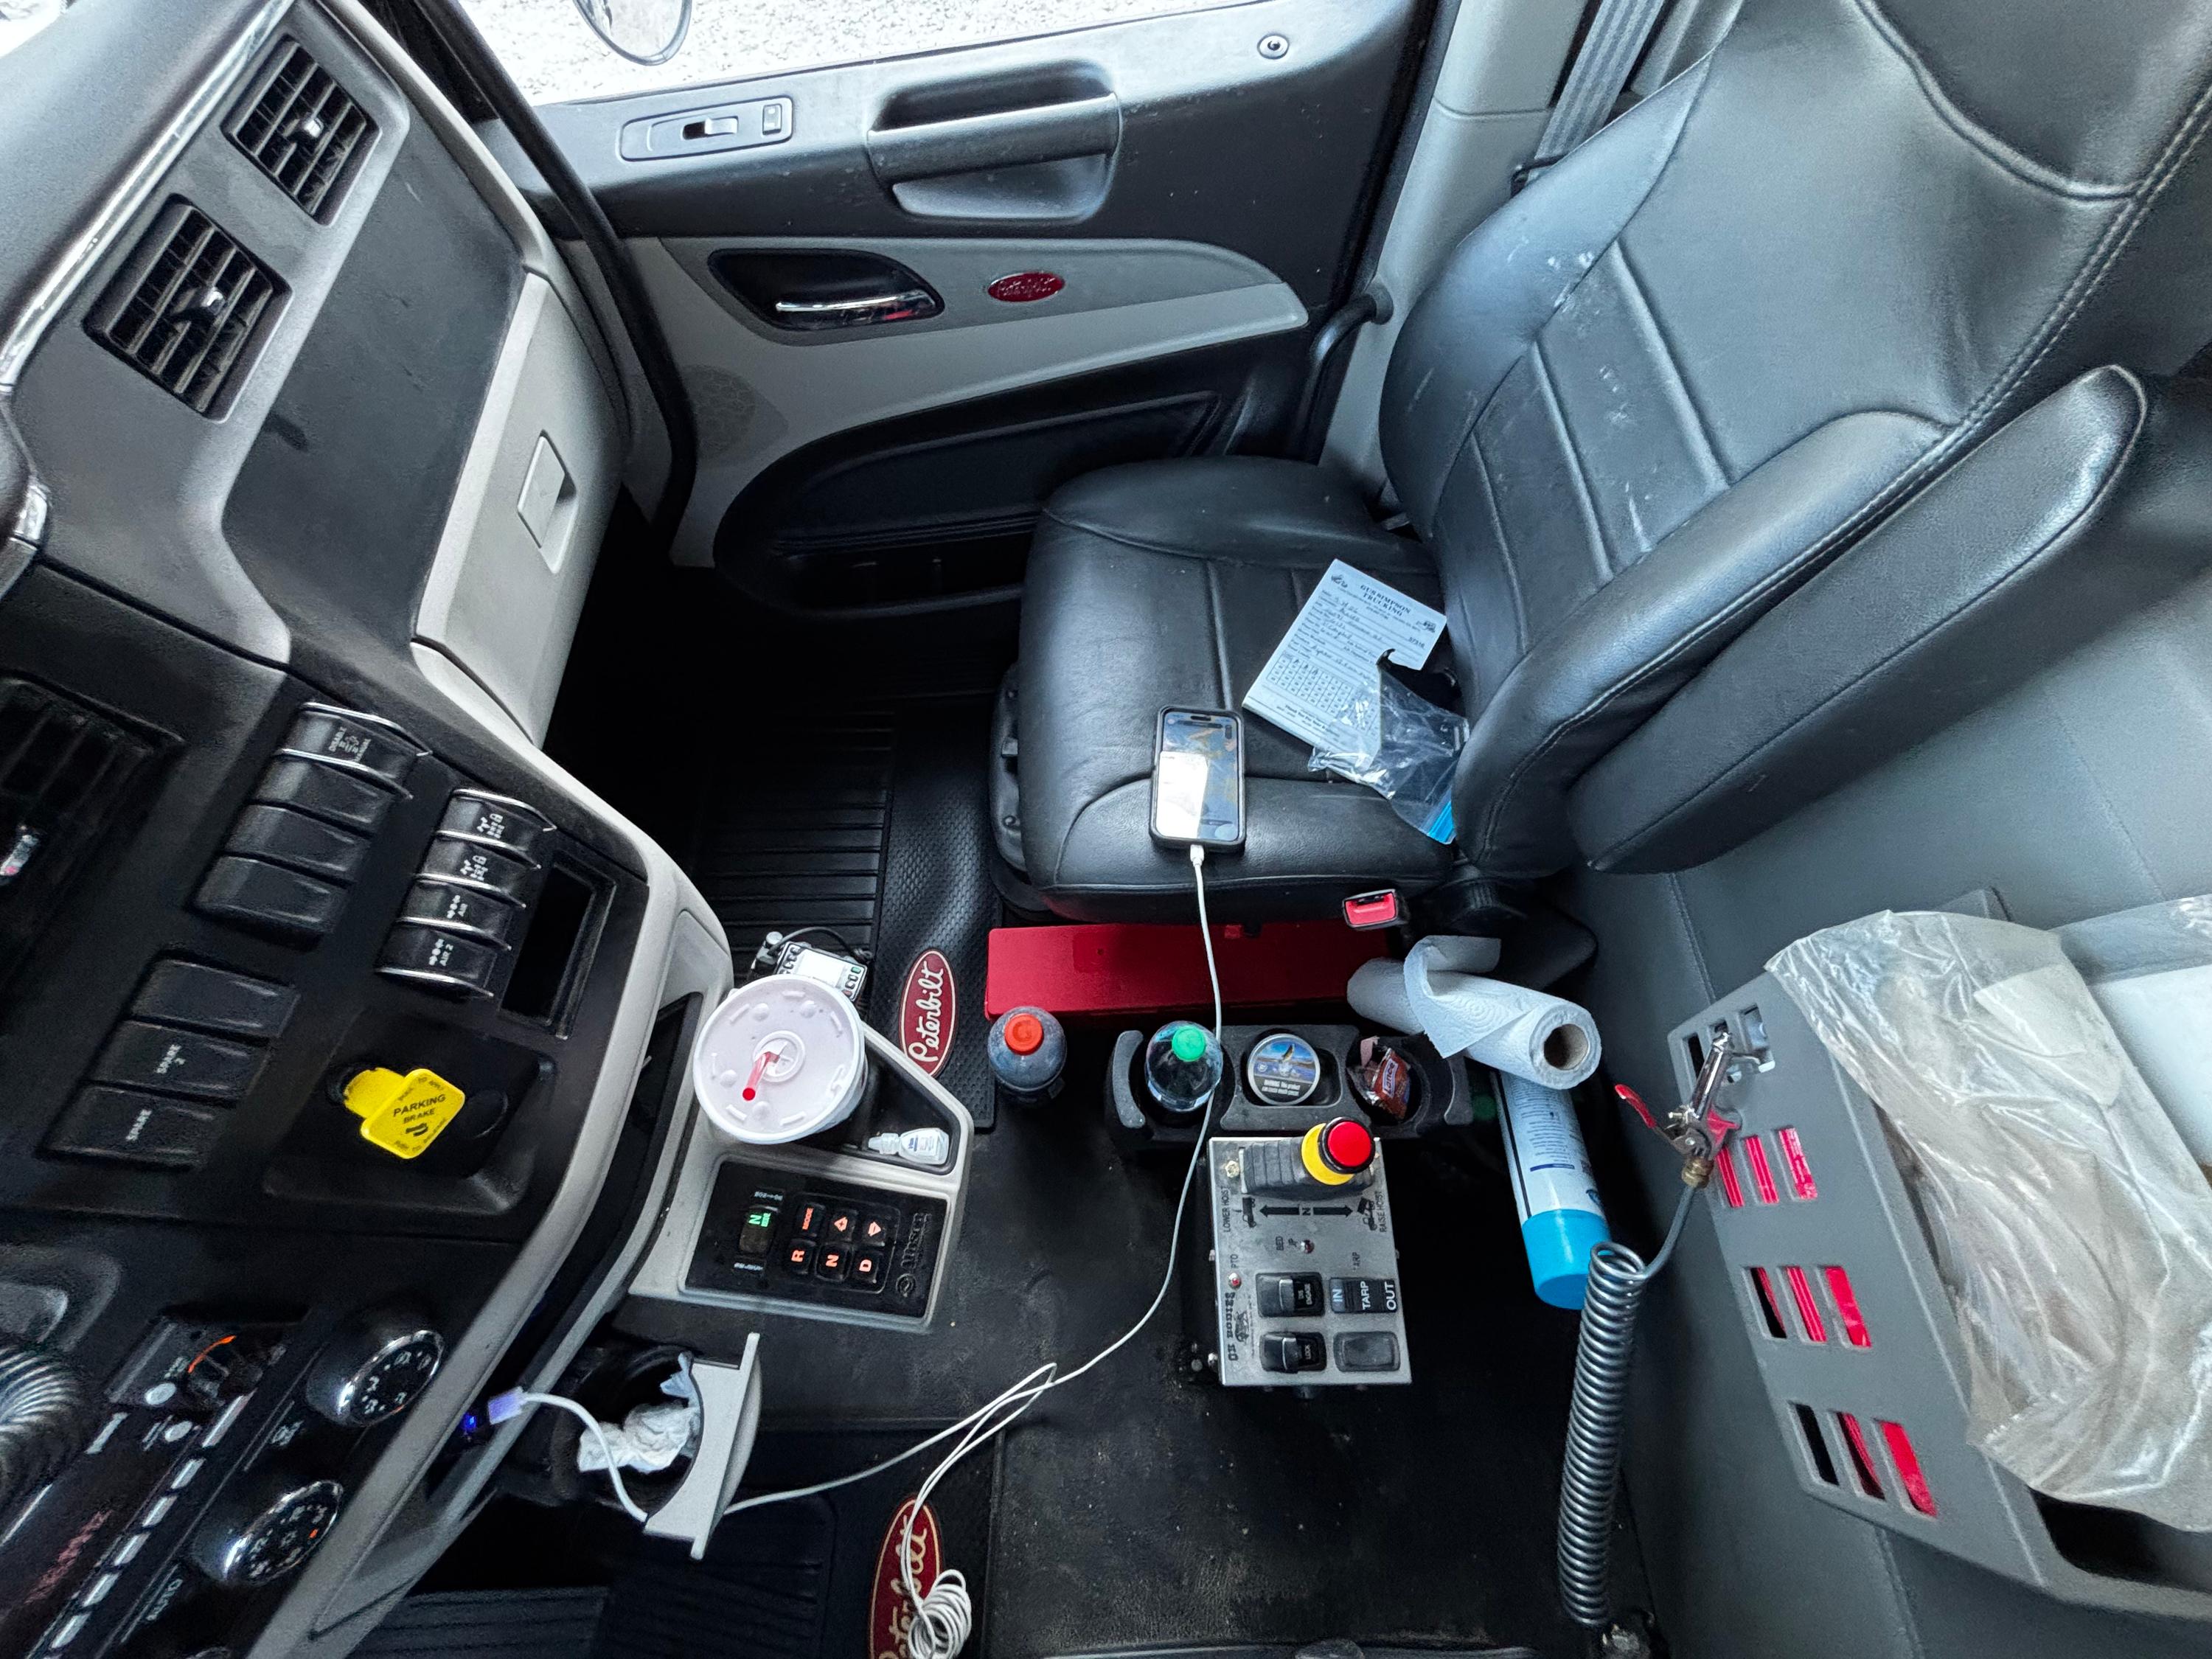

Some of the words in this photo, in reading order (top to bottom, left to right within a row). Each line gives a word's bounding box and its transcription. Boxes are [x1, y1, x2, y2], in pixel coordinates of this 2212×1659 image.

[1363, 593, 1402, 616] TRUCKING
[1377, 592, 1411, 614] SIMPSON
[908, 960, 944, 1062] Peterbilt
[1383, 1062, 1395, 1095] Lance
[393, 1093, 446, 1118] PARKING
[403, 1108, 437, 1124] BRAKE
[1220, 1186, 1230, 1207] HOIST
[748, 1214, 762, 1225] N
[1222, 1207, 1231, 1233] LOWER
[1301, 1207, 1311, 1216] N
[1379, 1210, 1387, 1232] RAISE
[1276, 1236, 1284, 1251] BED
[790, 1249, 805, 1263] R
[825, 1254, 839, 1267] N
[858, 1259, 872, 1273] D
[1229, 1253, 1239, 1270] PTO
[1332, 1288, 1343, 1303] IN
[1360, 1281, 1371, 1310] TARP
[1384, 1281, 1397, 1311] OUT
[1224, 1291, 1237, 1338] BODIES
